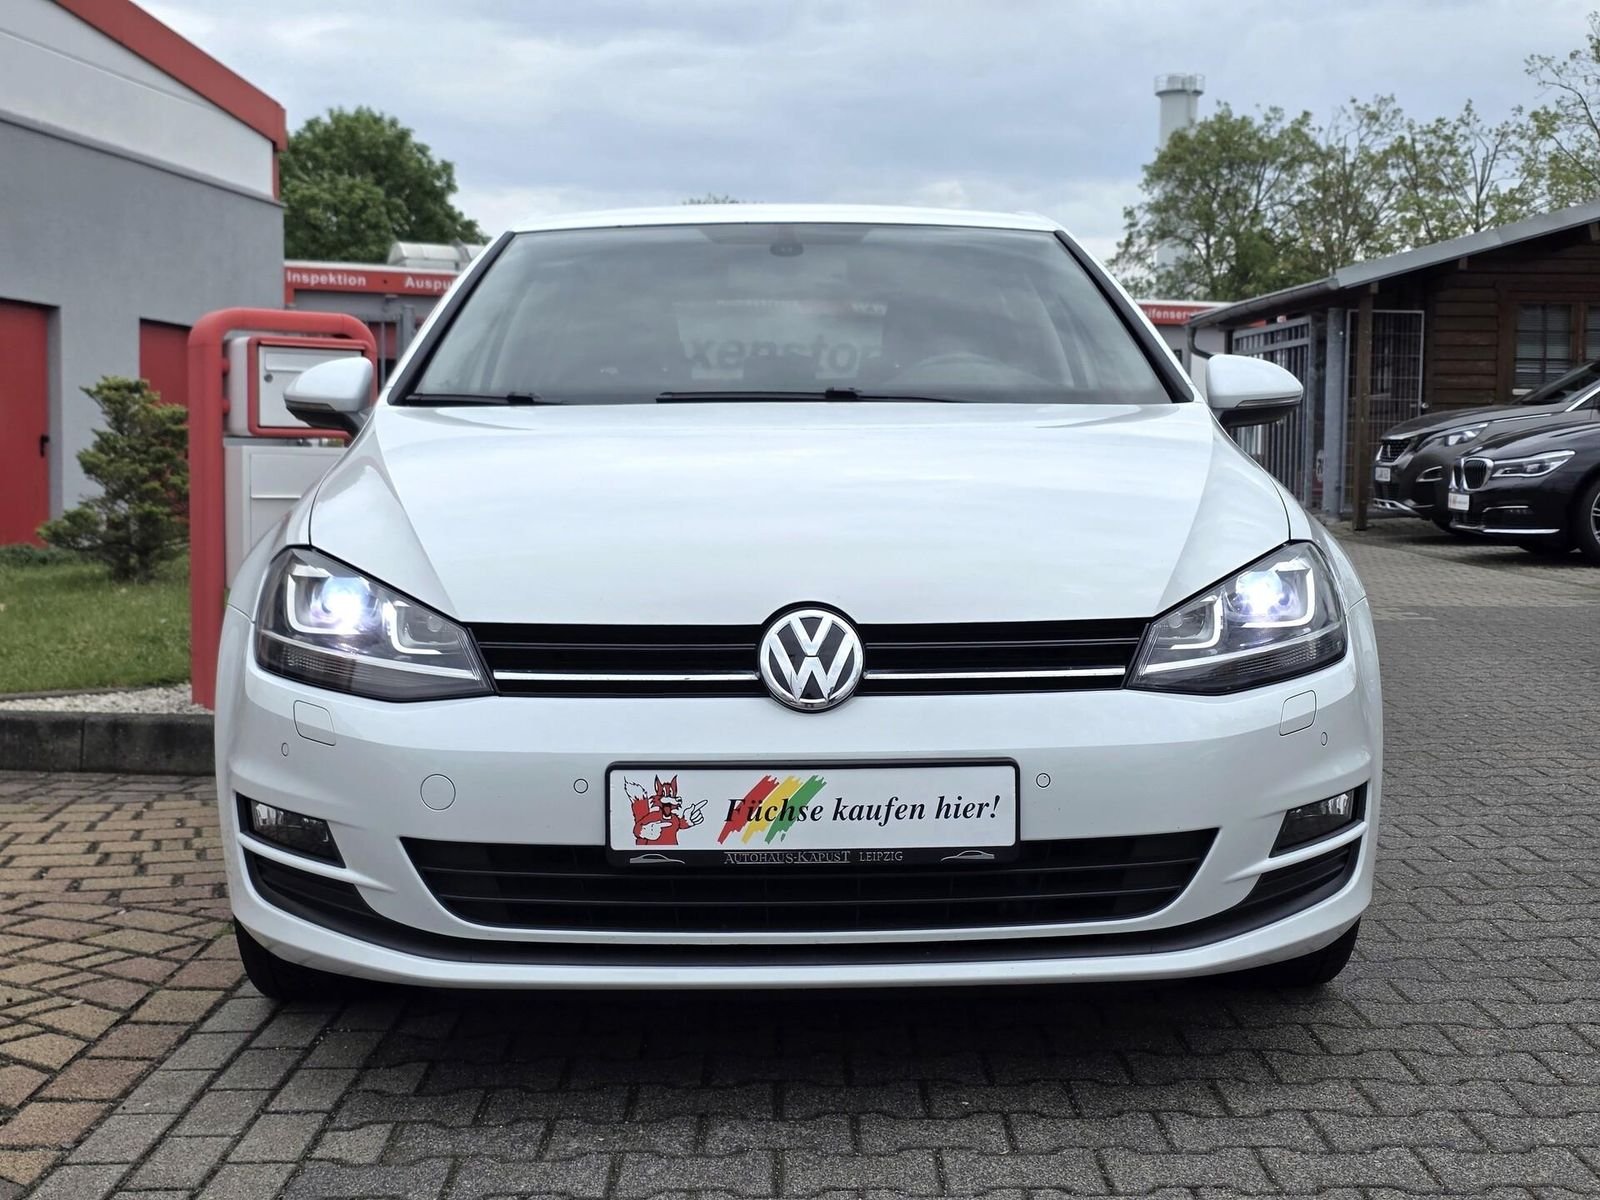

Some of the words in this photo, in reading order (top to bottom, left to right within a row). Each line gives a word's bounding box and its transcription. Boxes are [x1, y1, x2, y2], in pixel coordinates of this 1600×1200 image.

[287, 270, 367, 288] Inspektion
[404, 275, 455, 293] Auspu
[724, 797, 824, 822] Füchse
[832, 796, 926, 827] kaufen
[935, 795, 1001, 820] hier!
[859, 851, 904, 863] LEIPZIG
